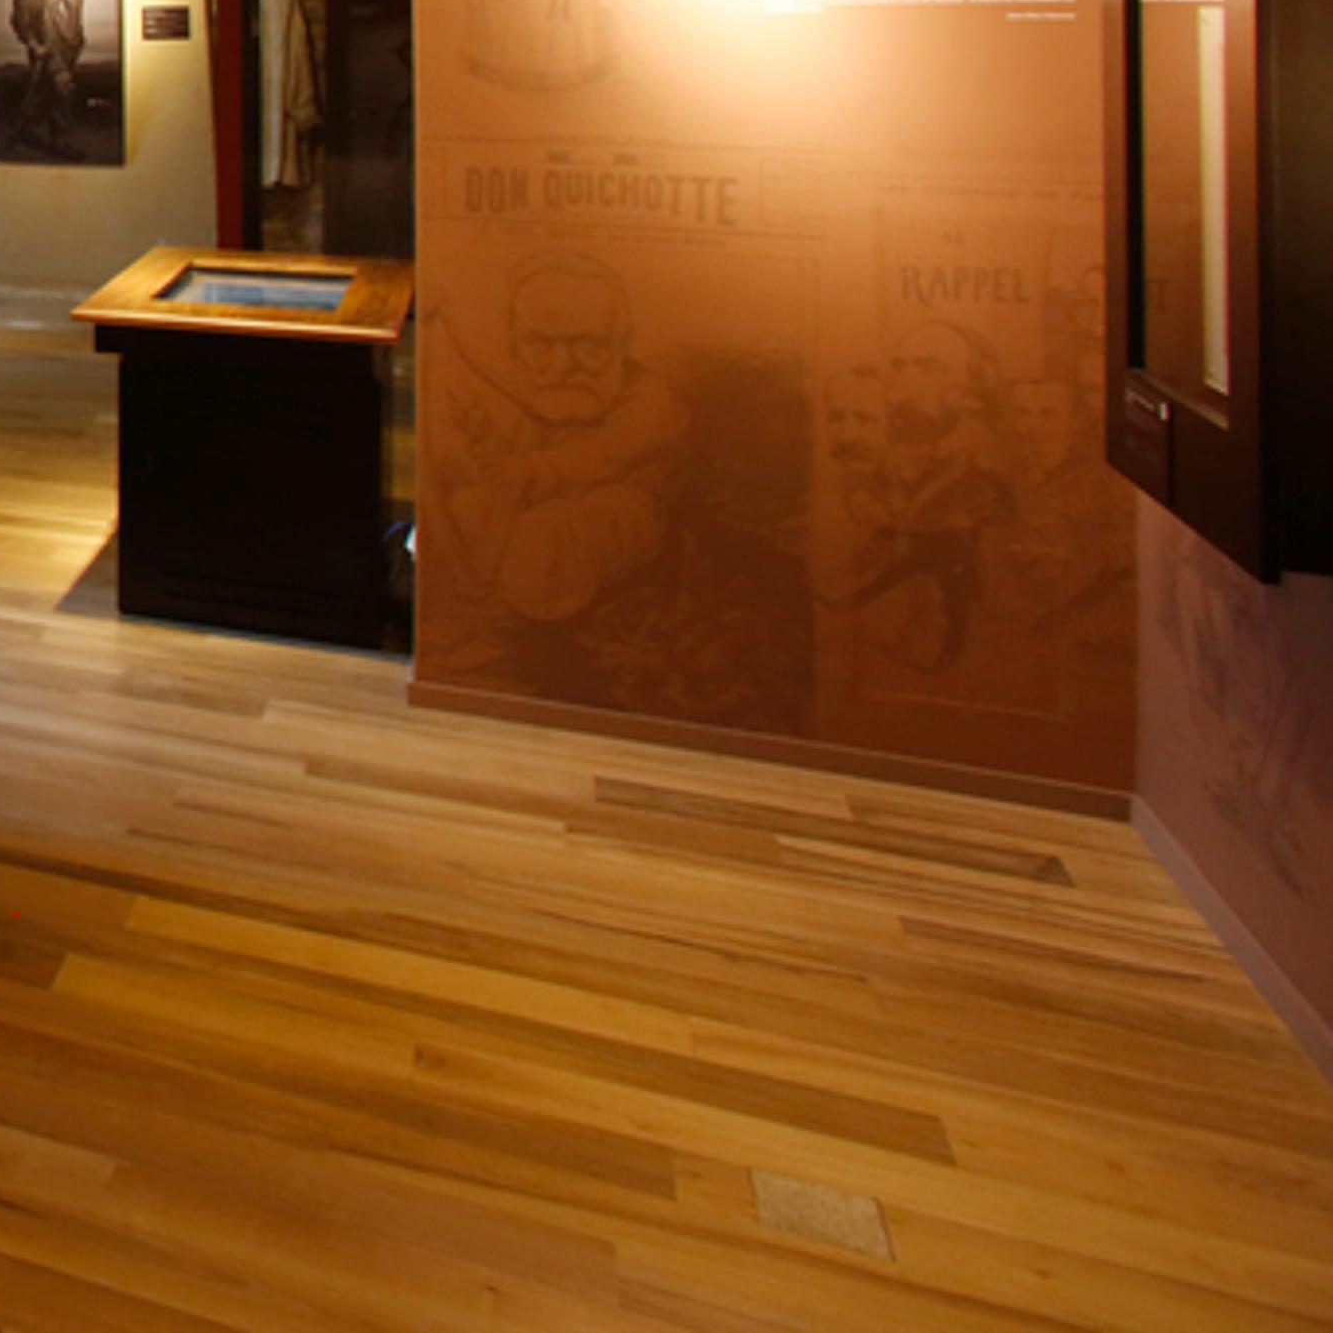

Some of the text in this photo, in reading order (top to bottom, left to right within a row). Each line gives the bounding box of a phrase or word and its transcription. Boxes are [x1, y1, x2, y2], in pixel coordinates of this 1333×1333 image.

[465, 167, 738, 226] DON QUICHOTTE
[899, 264, 1031, 308] RAPPEL
